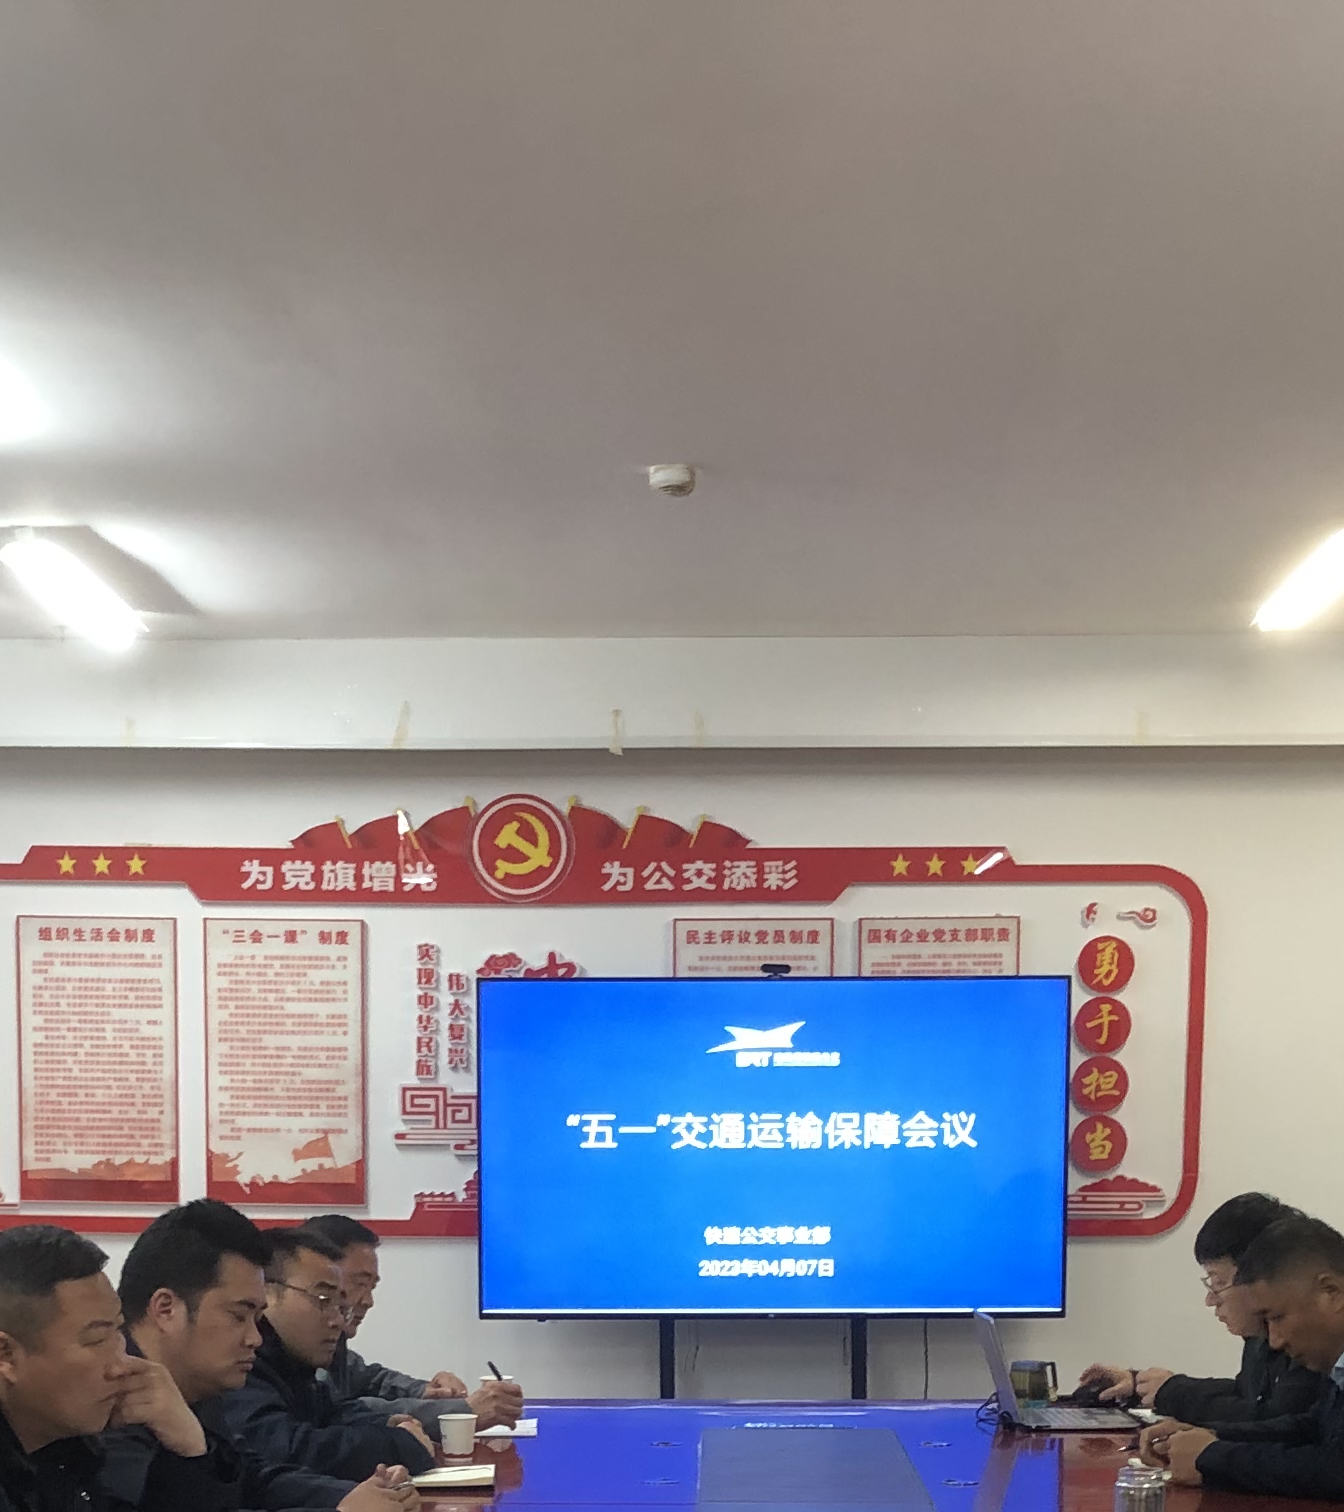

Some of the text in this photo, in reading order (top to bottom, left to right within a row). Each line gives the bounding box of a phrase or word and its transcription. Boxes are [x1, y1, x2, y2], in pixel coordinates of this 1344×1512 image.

[240, 859, 438, 892] 为党旗增光
[601, 859, 799, 892] 为公交添彩
[37, 926, 156, 943] 组织生活会制度
[685, 928, 822, 945] 民主评议党员制度
[867, 927, 1011, 944] 国有企业党支部职责
[414, 942, 436, 1078] 实现中华民族
[447, 971, 467, 1066] 伟大复兴
[1081, 940, 1121, 1161] 勇于担当
[566, 1110, 979, 1151] “五一”交通运输保障会议
[698, 1258, 835, 1278] 2023年04月07日
